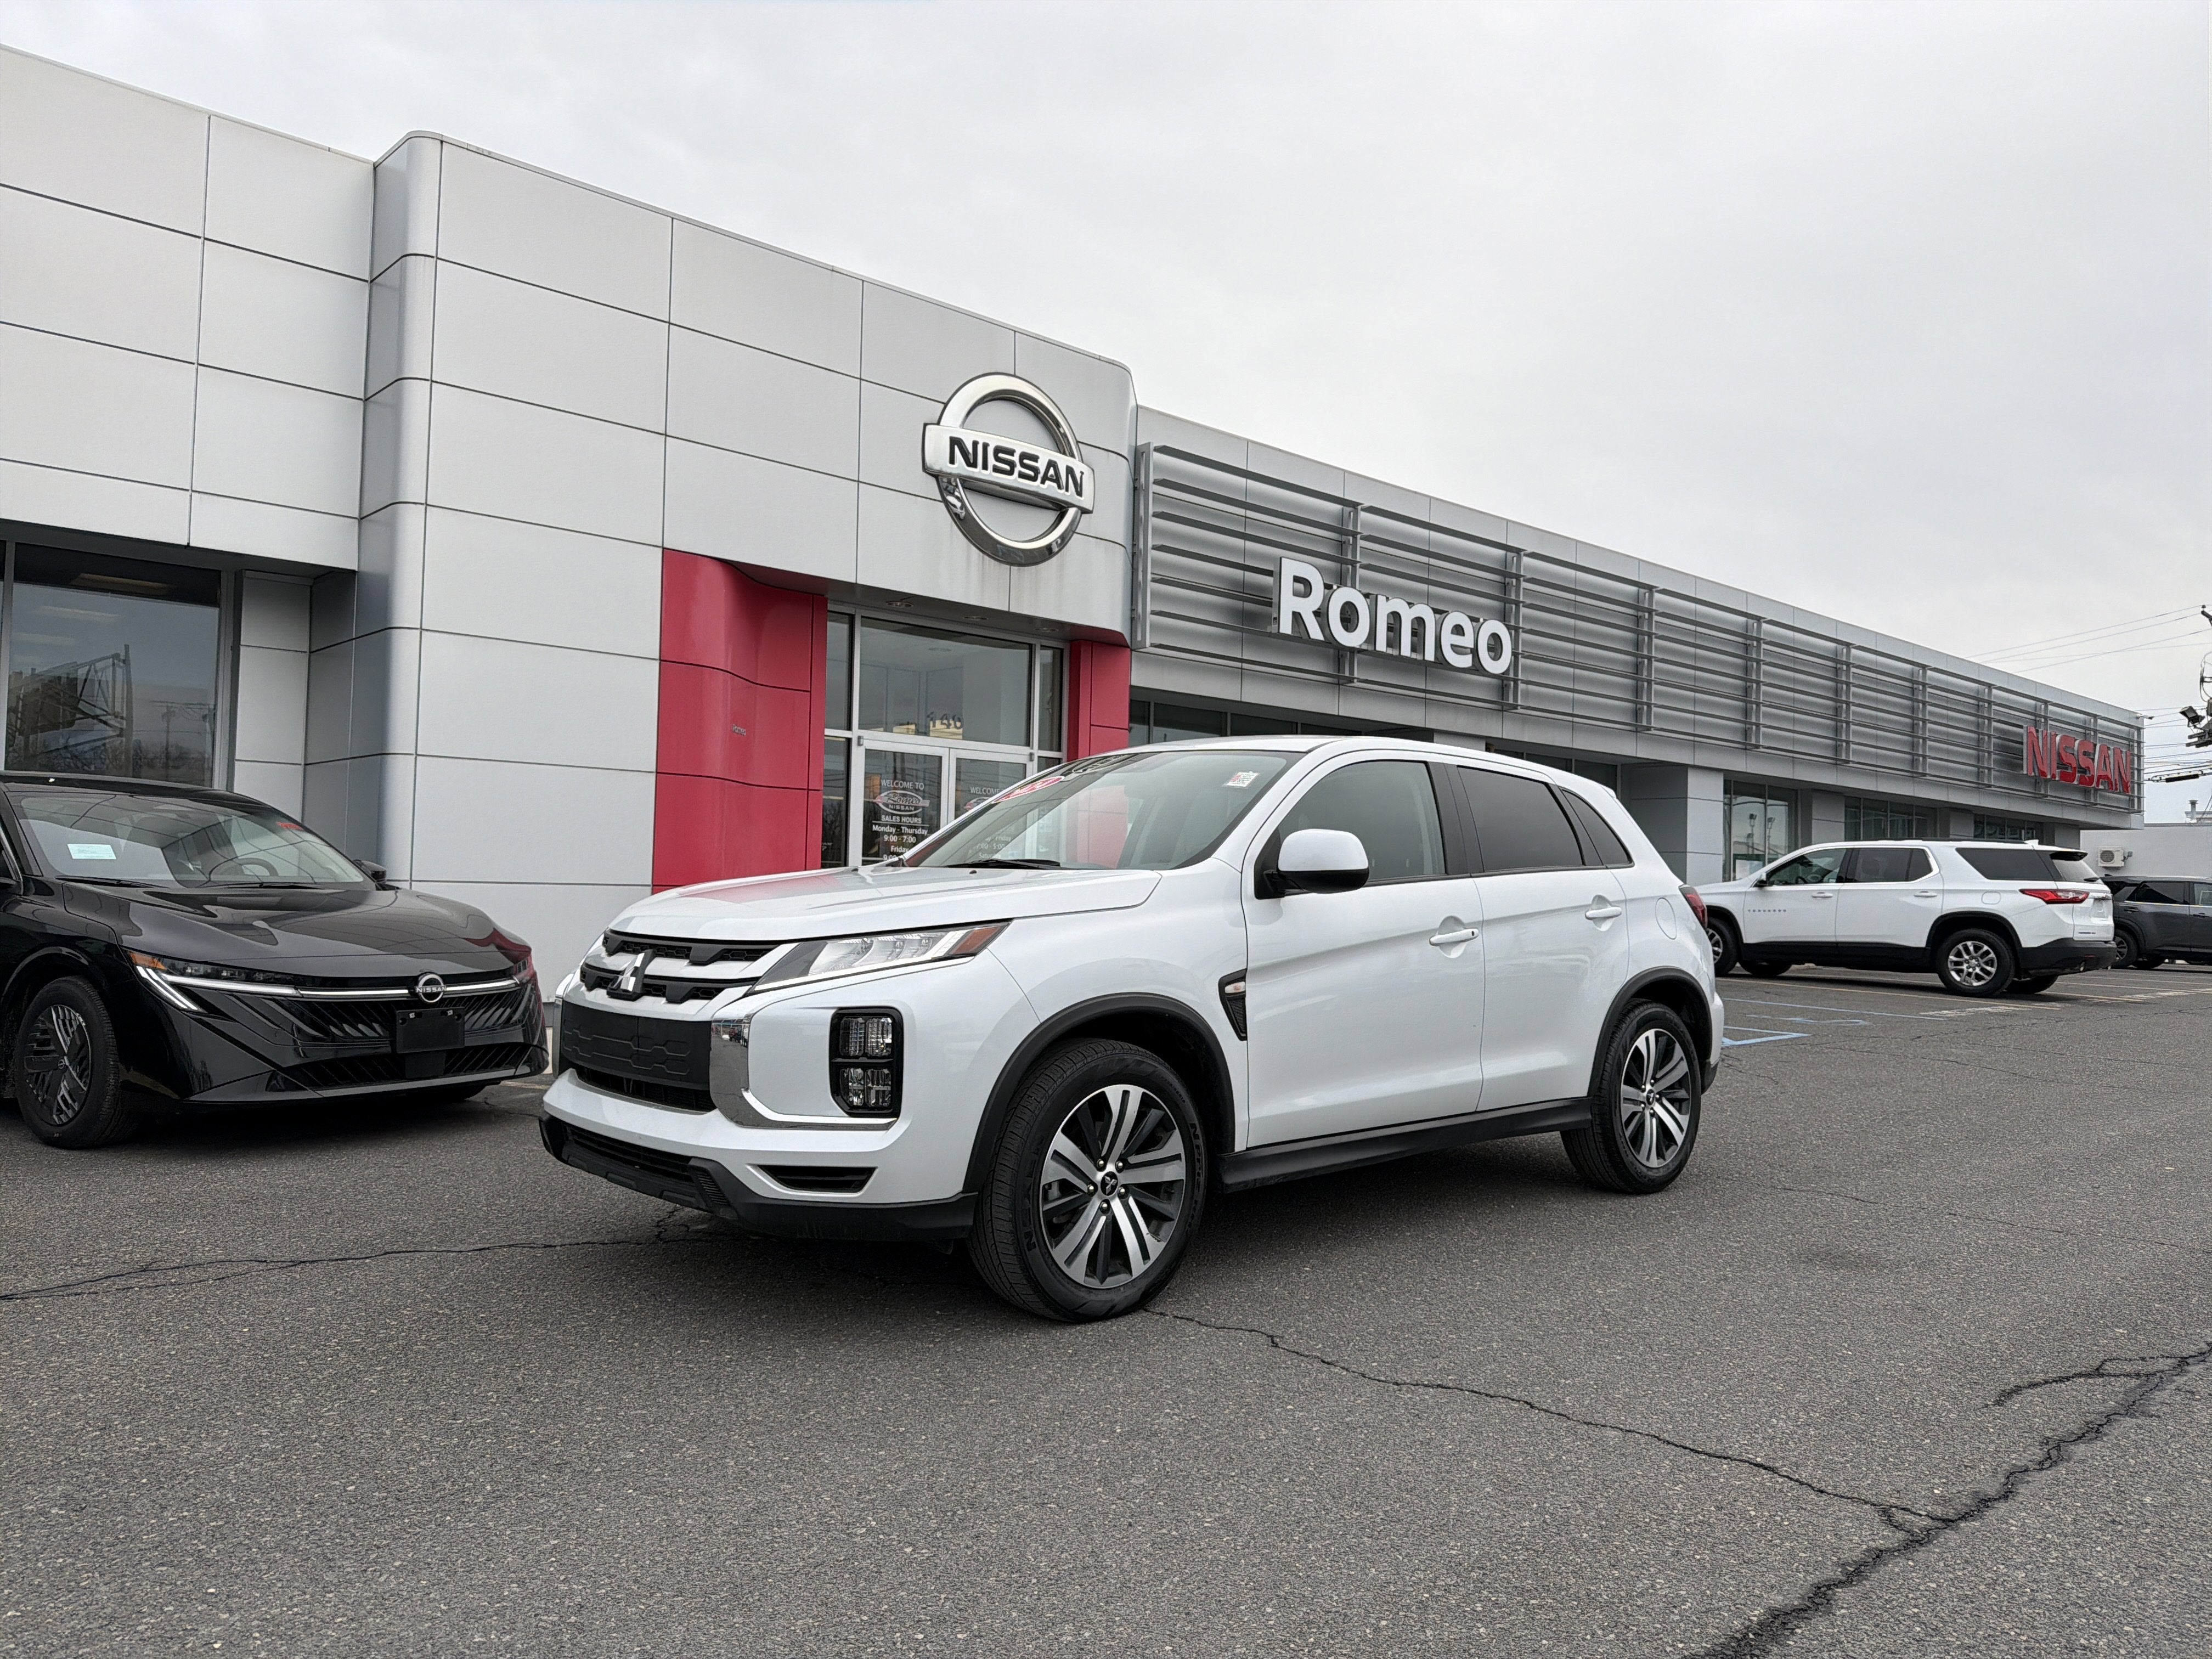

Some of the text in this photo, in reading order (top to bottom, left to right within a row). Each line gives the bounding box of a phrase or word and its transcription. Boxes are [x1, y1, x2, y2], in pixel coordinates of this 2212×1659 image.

[949, 436, 1085, 499] NISSAN
[1278, 556, 1513, 674] Romeo
[2027, 726, 2131, 794] NISSAN
[881, 779, 924, 790] WELCOME TO
[884, 791, 921, 805] Romeo
[872, 824, 896, 834] Monday
[901, 826, 928, 836] Thursday
